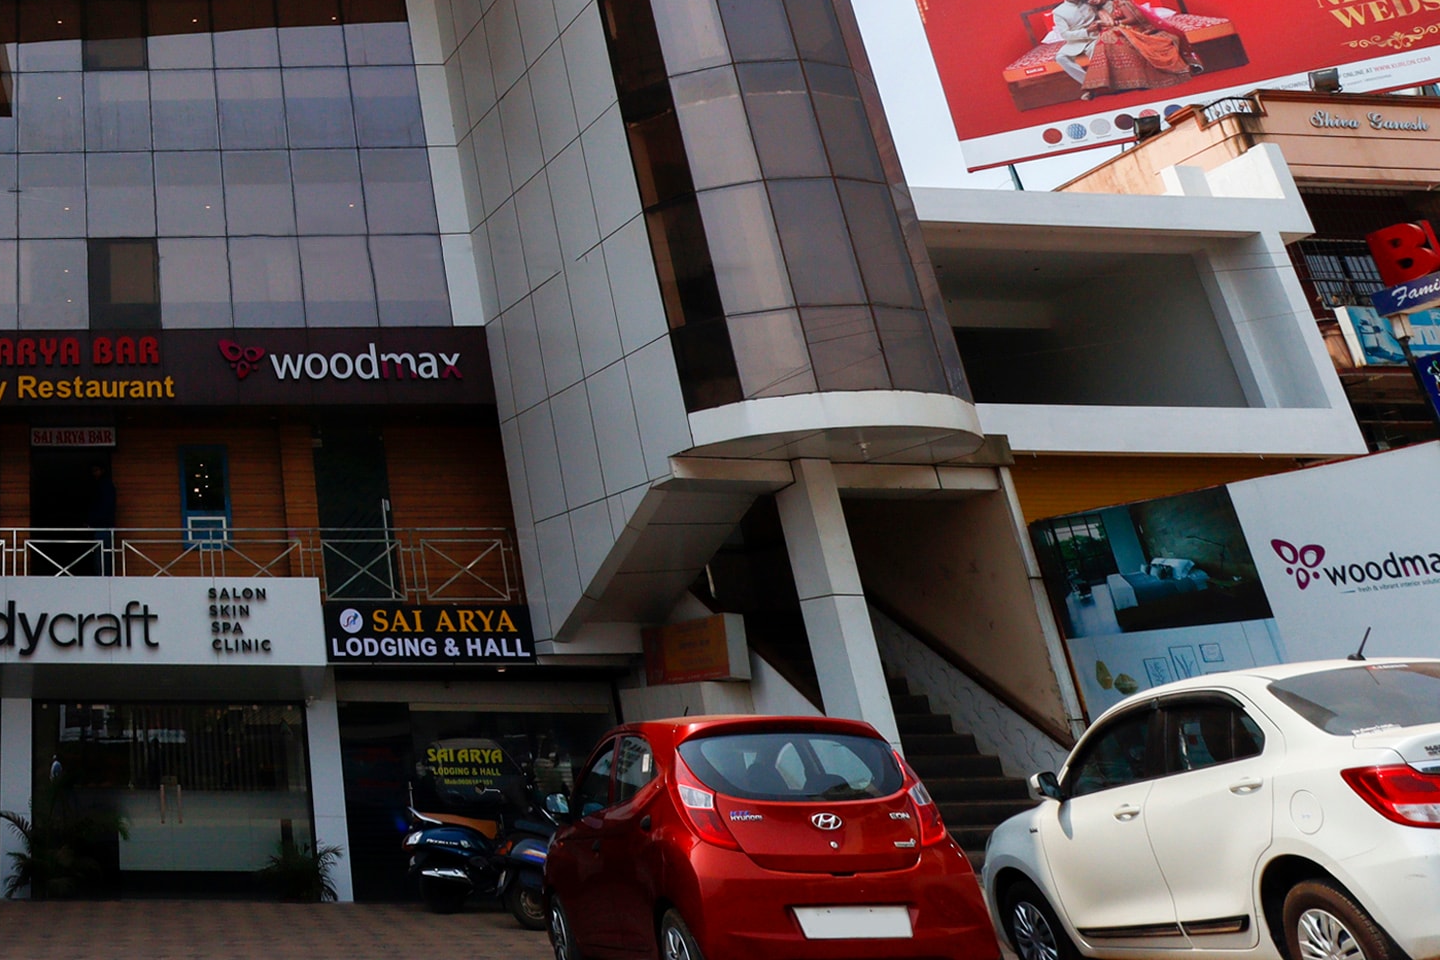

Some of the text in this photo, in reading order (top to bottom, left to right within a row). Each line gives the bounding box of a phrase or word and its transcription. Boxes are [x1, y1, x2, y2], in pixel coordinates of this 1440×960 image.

[1310, 109, 1431, 131] Shiva Ganesh
[92, 335, 160, 366] BAR
[269, 342, 464, 381] woodmax
[18, 375, 176, 400] Restaurant
[34, 431, 113, 444] SAI ARYA BAR
[208, 587, 267, 601] SALON
[209, 604, 250, 618] SKIN
[211, 621, 244, 634] SPA
[372, 609, 519, 633] SAI ARYA
[212, 638, 272, 653] CLINIC
[332, 637, 531, 658] LODGING & HALL
[426, 747, 503, 765] SAI ARYA
[431, 766, 470, 777] LODGING
[480, 767, 502, 777] HALL
